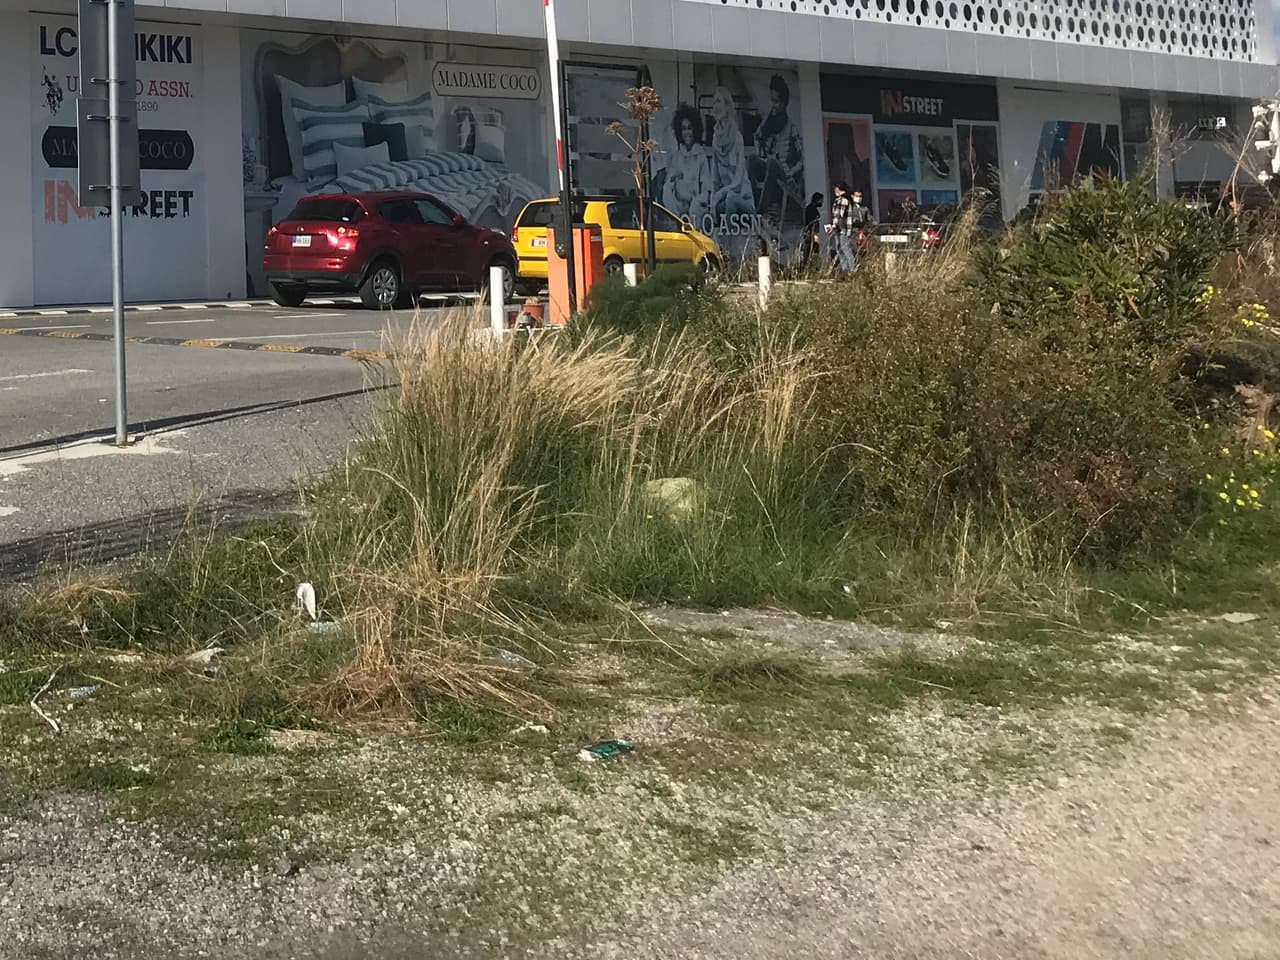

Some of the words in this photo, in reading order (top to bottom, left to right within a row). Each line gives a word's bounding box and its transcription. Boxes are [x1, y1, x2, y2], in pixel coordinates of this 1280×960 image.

[39, 26, 78, 57] LC
[438, 70, 496, 89] MADAME
[500, 73, 537, 92] COCO
[903, 95, 943, 116] STREET
